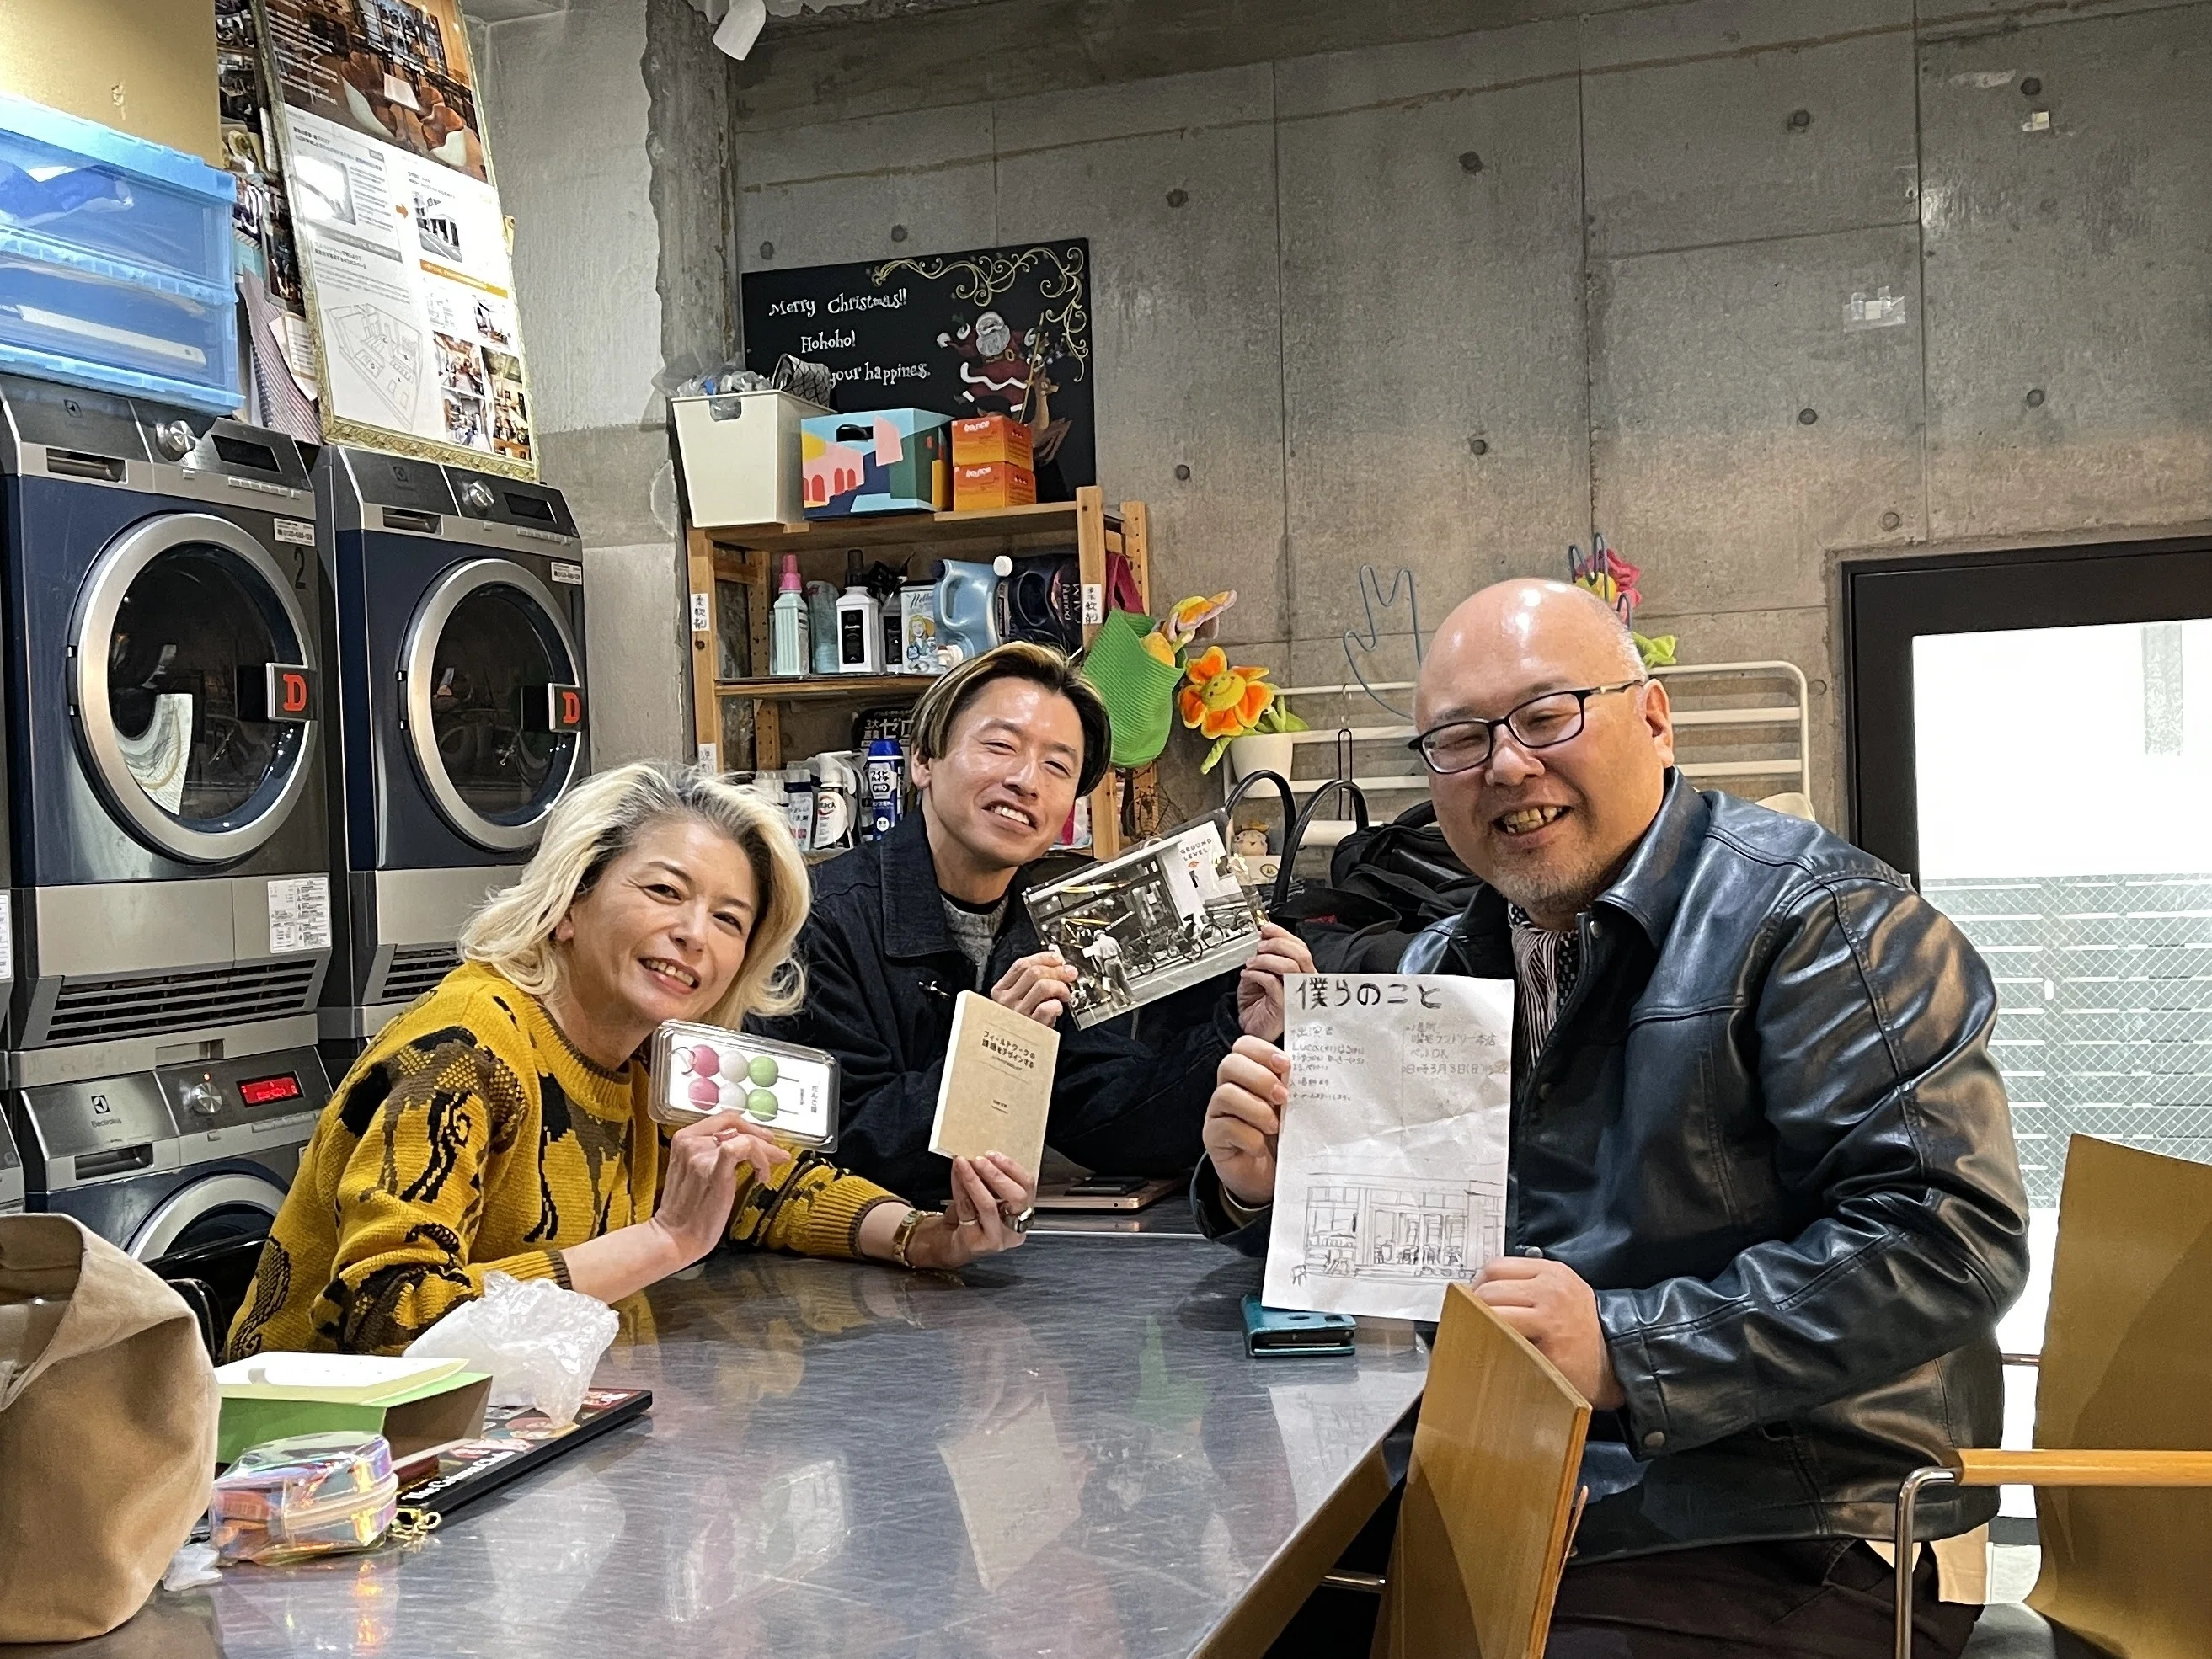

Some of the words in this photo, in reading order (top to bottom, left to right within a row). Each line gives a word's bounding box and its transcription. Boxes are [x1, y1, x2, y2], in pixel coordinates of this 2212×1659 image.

[769, 300, 815, 317] Merry
[827, 288, 907, 314] Christmas!!
[801, 329, 856, 353] Hohoho!
[830, 371, 862, 389] your
[293, 546, 306, 589] 2
[283, 673, 307, 712] D
[562, 691, 580, 724] D
[1180, 838, 1212, 854] GROUND
[1183, 848, 1209, 861] LEVEL
[1296, 977, 1443, 1011] 僕らのこと
